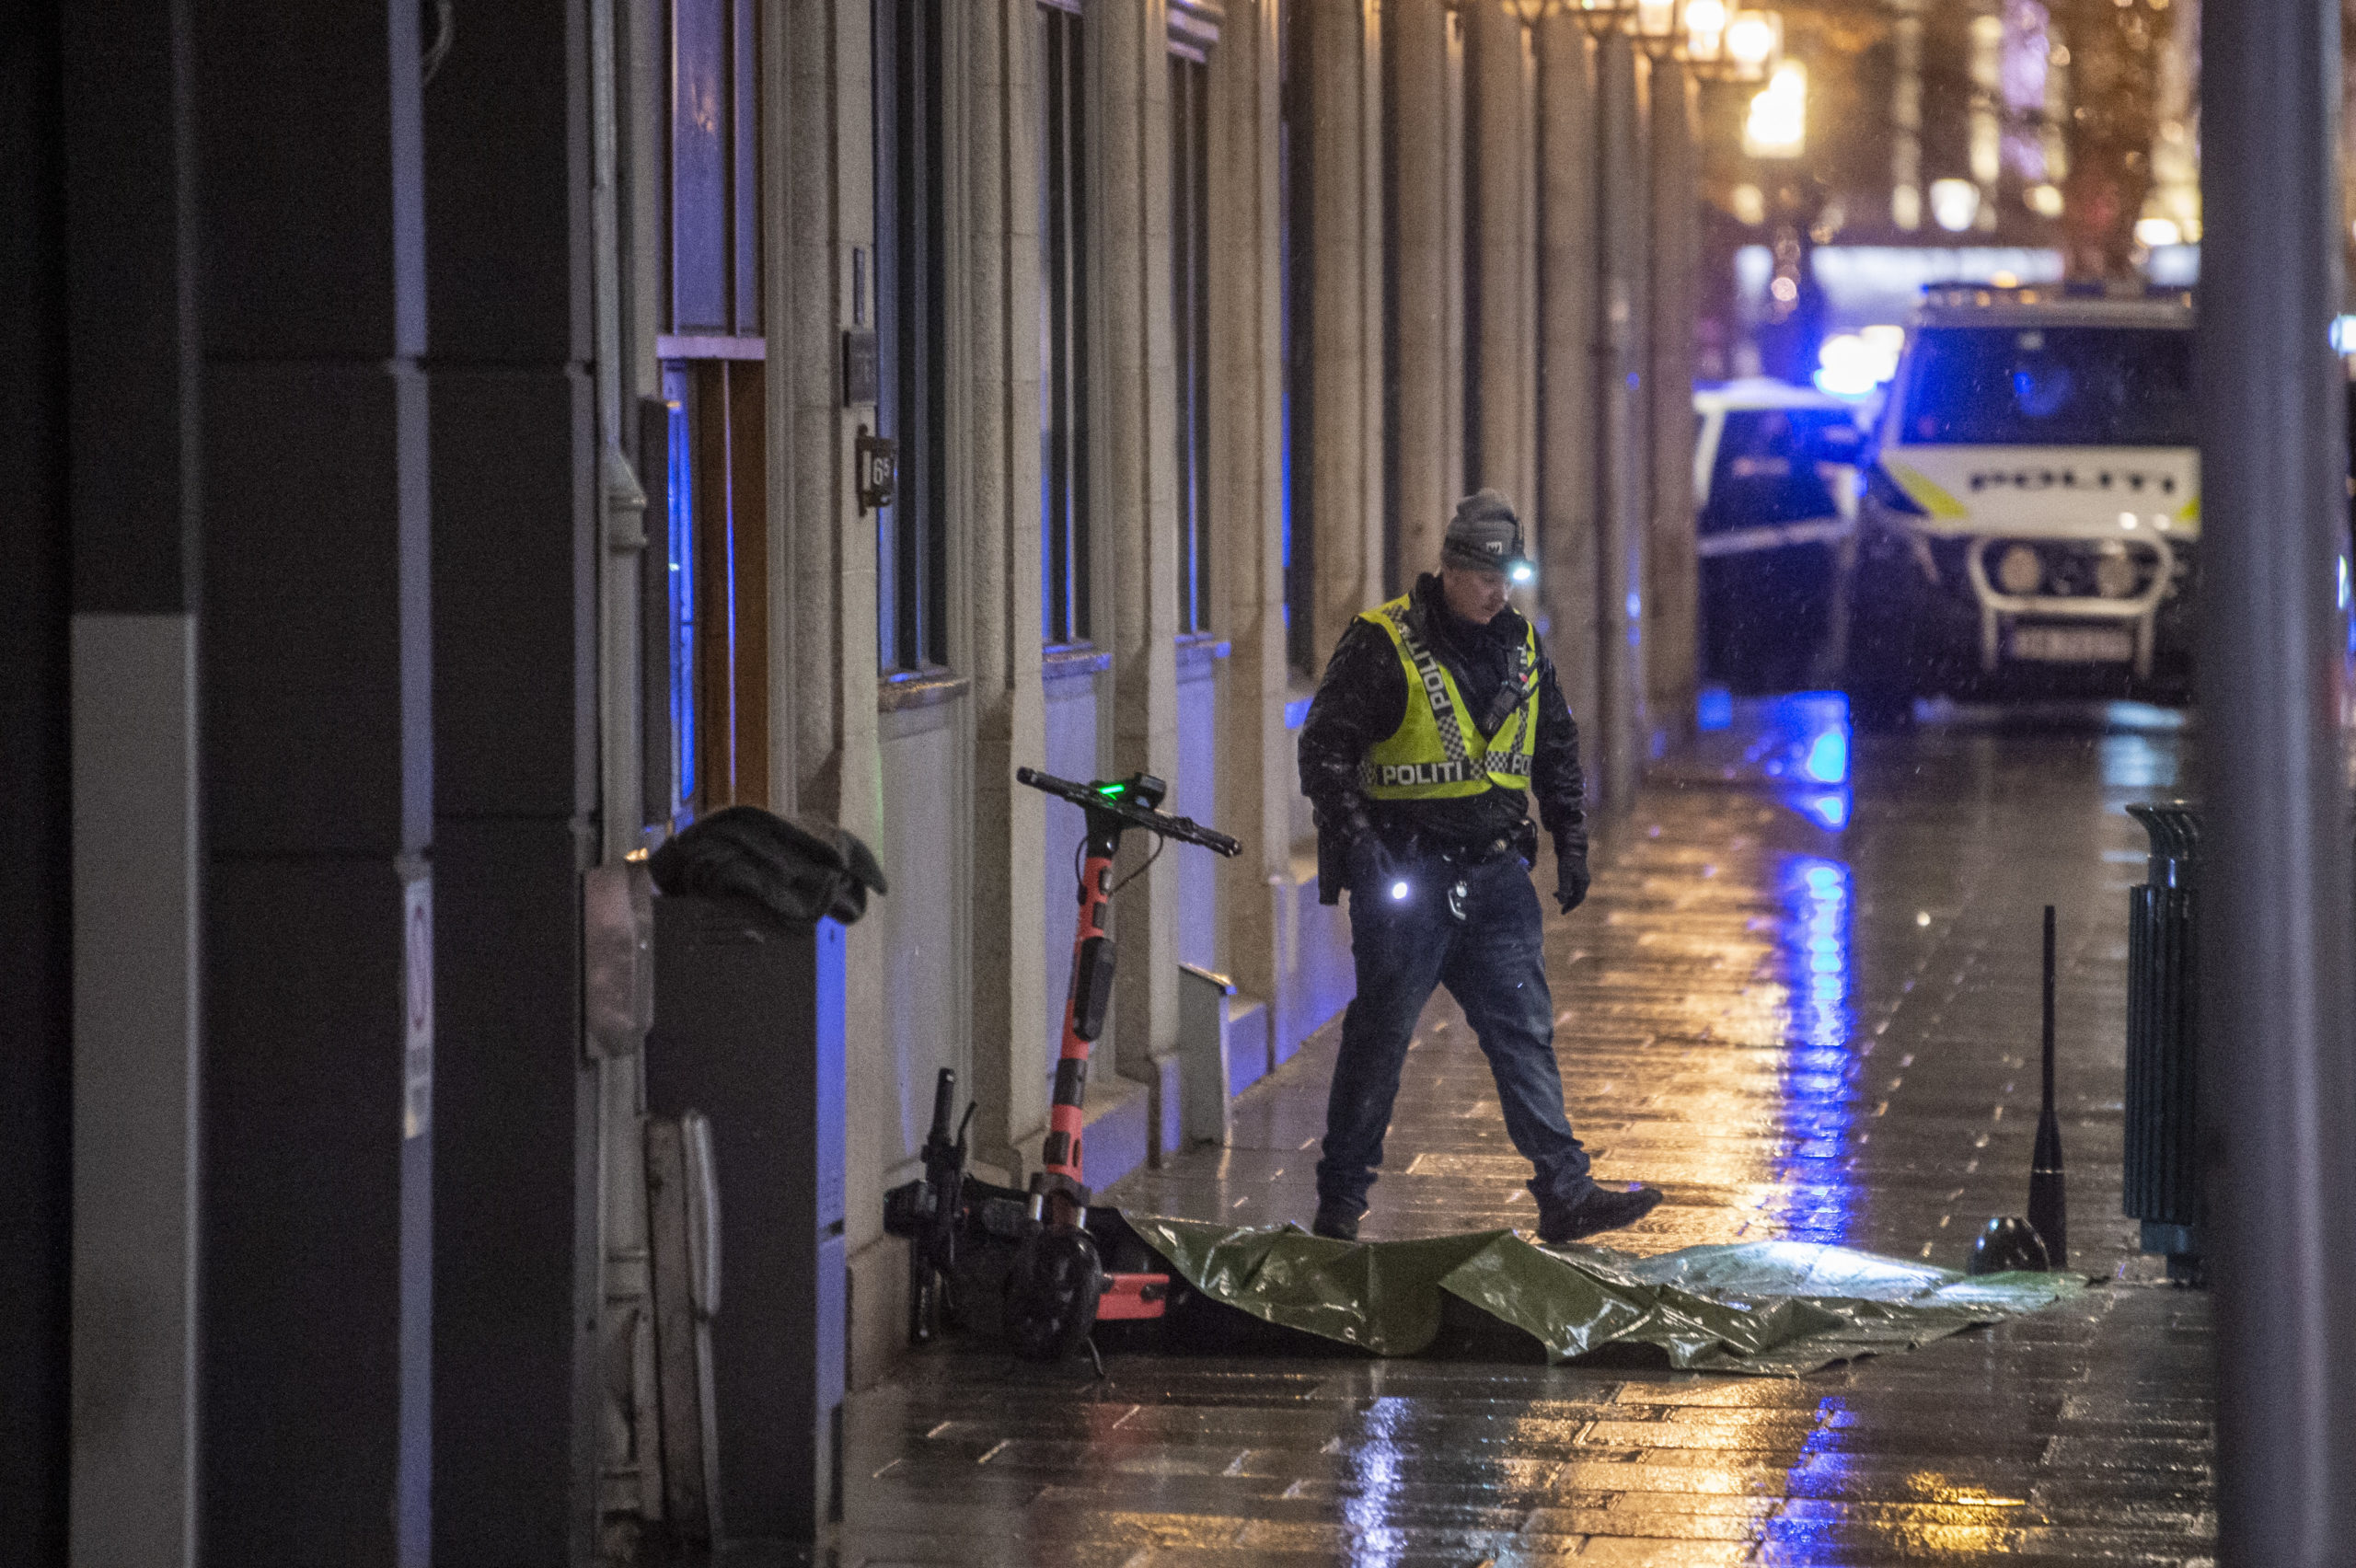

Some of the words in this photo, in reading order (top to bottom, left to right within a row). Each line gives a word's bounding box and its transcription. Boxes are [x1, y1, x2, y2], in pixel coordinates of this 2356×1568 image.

[1969, 466, 2176, 494] POLITI
[1382, 761, 1463, 785] POLITI
[1511, 754, 1531, 777] PO
